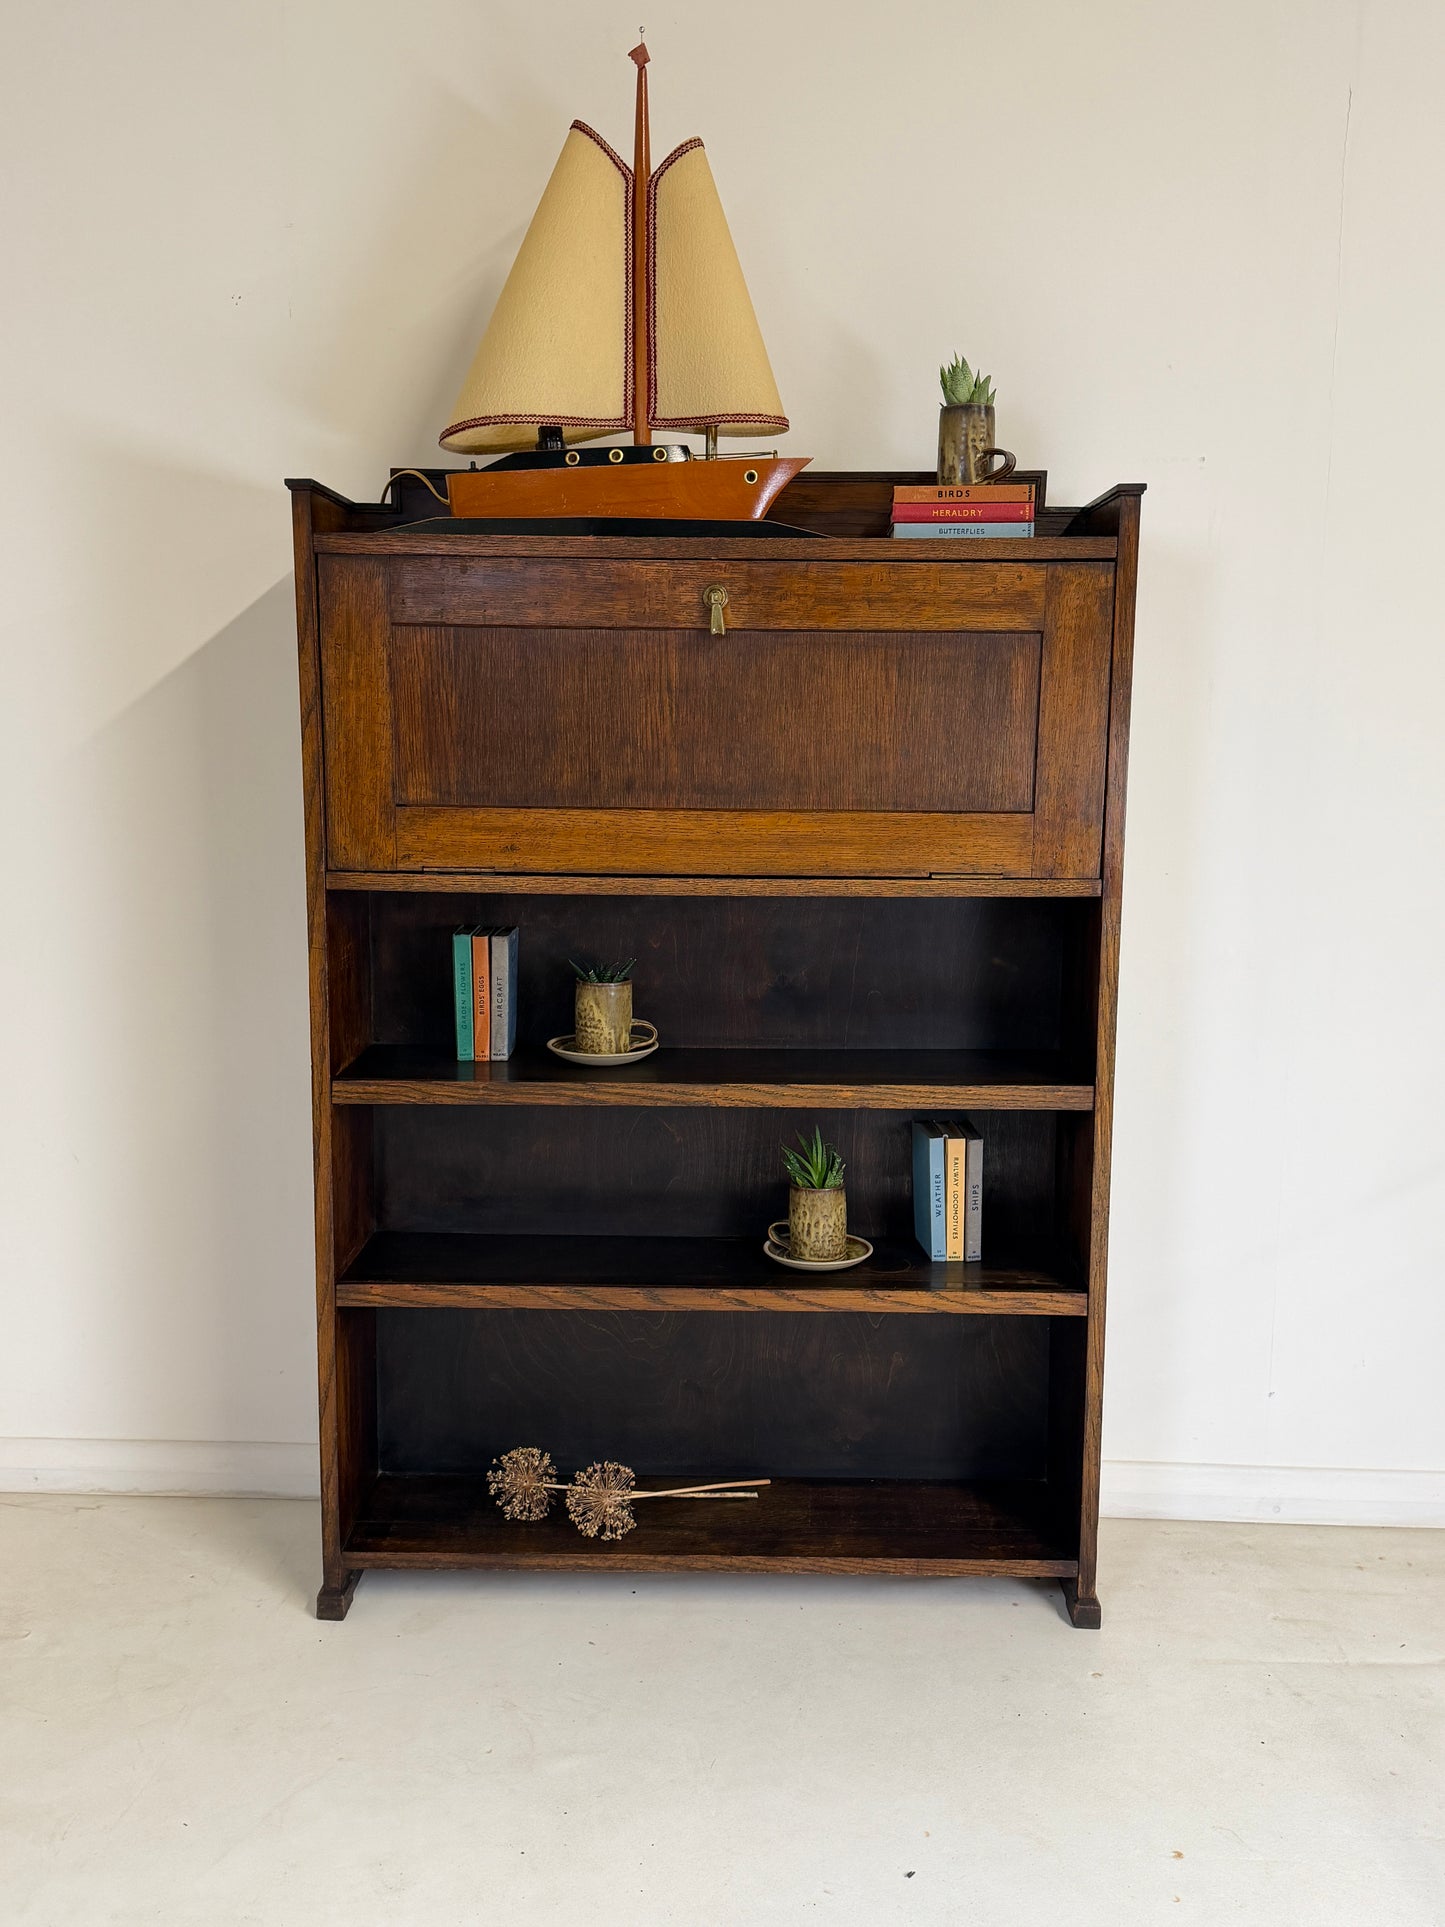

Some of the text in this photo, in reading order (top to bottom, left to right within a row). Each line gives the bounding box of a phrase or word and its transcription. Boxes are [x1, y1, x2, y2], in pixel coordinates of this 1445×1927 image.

[937, 490, 970, 498] BIRDS
[932, 509, 983, 517] HERALDRY
[971, 1184, 980, 1211] SHIPS
